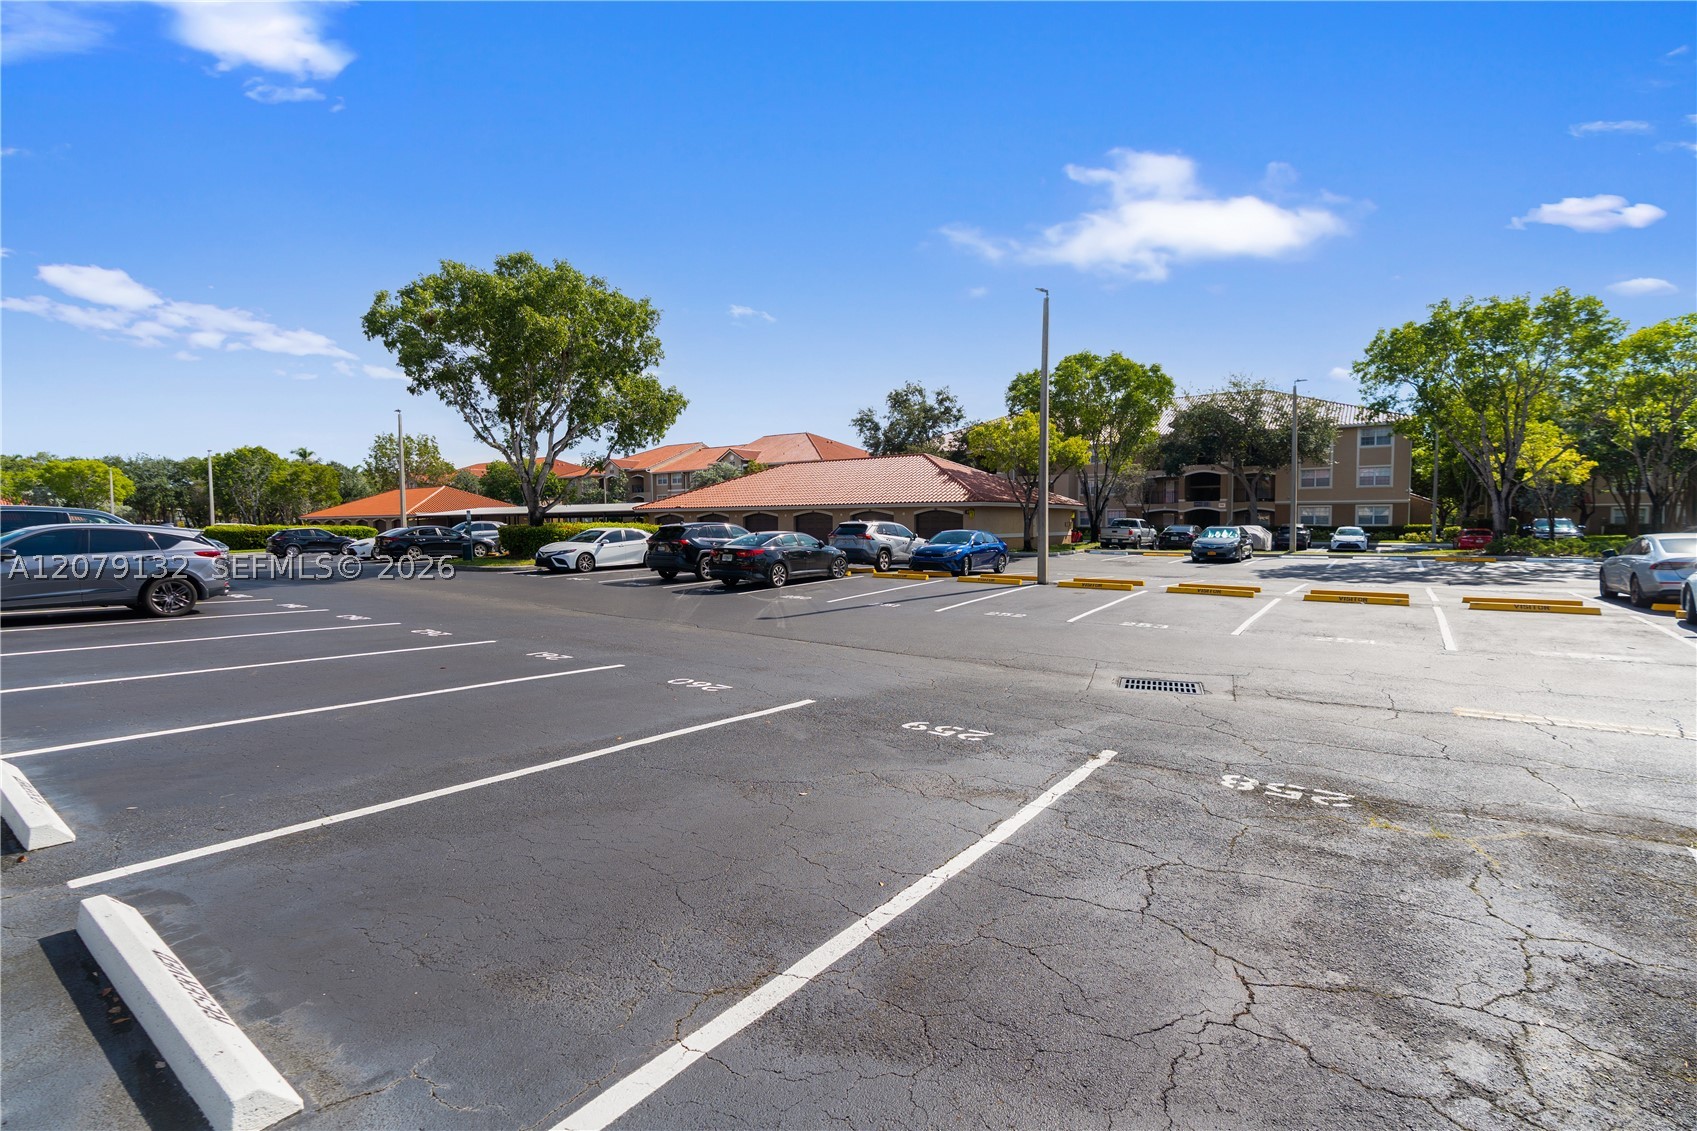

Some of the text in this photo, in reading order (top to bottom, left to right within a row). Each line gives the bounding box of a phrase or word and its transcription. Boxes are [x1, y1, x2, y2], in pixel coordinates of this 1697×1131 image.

[667, 677, 733, 692] 260
[902, 721, 995, 742] 259
[1220, 773, 1355, 809] 258
[151, 949, 235, 1027] RESERVED
